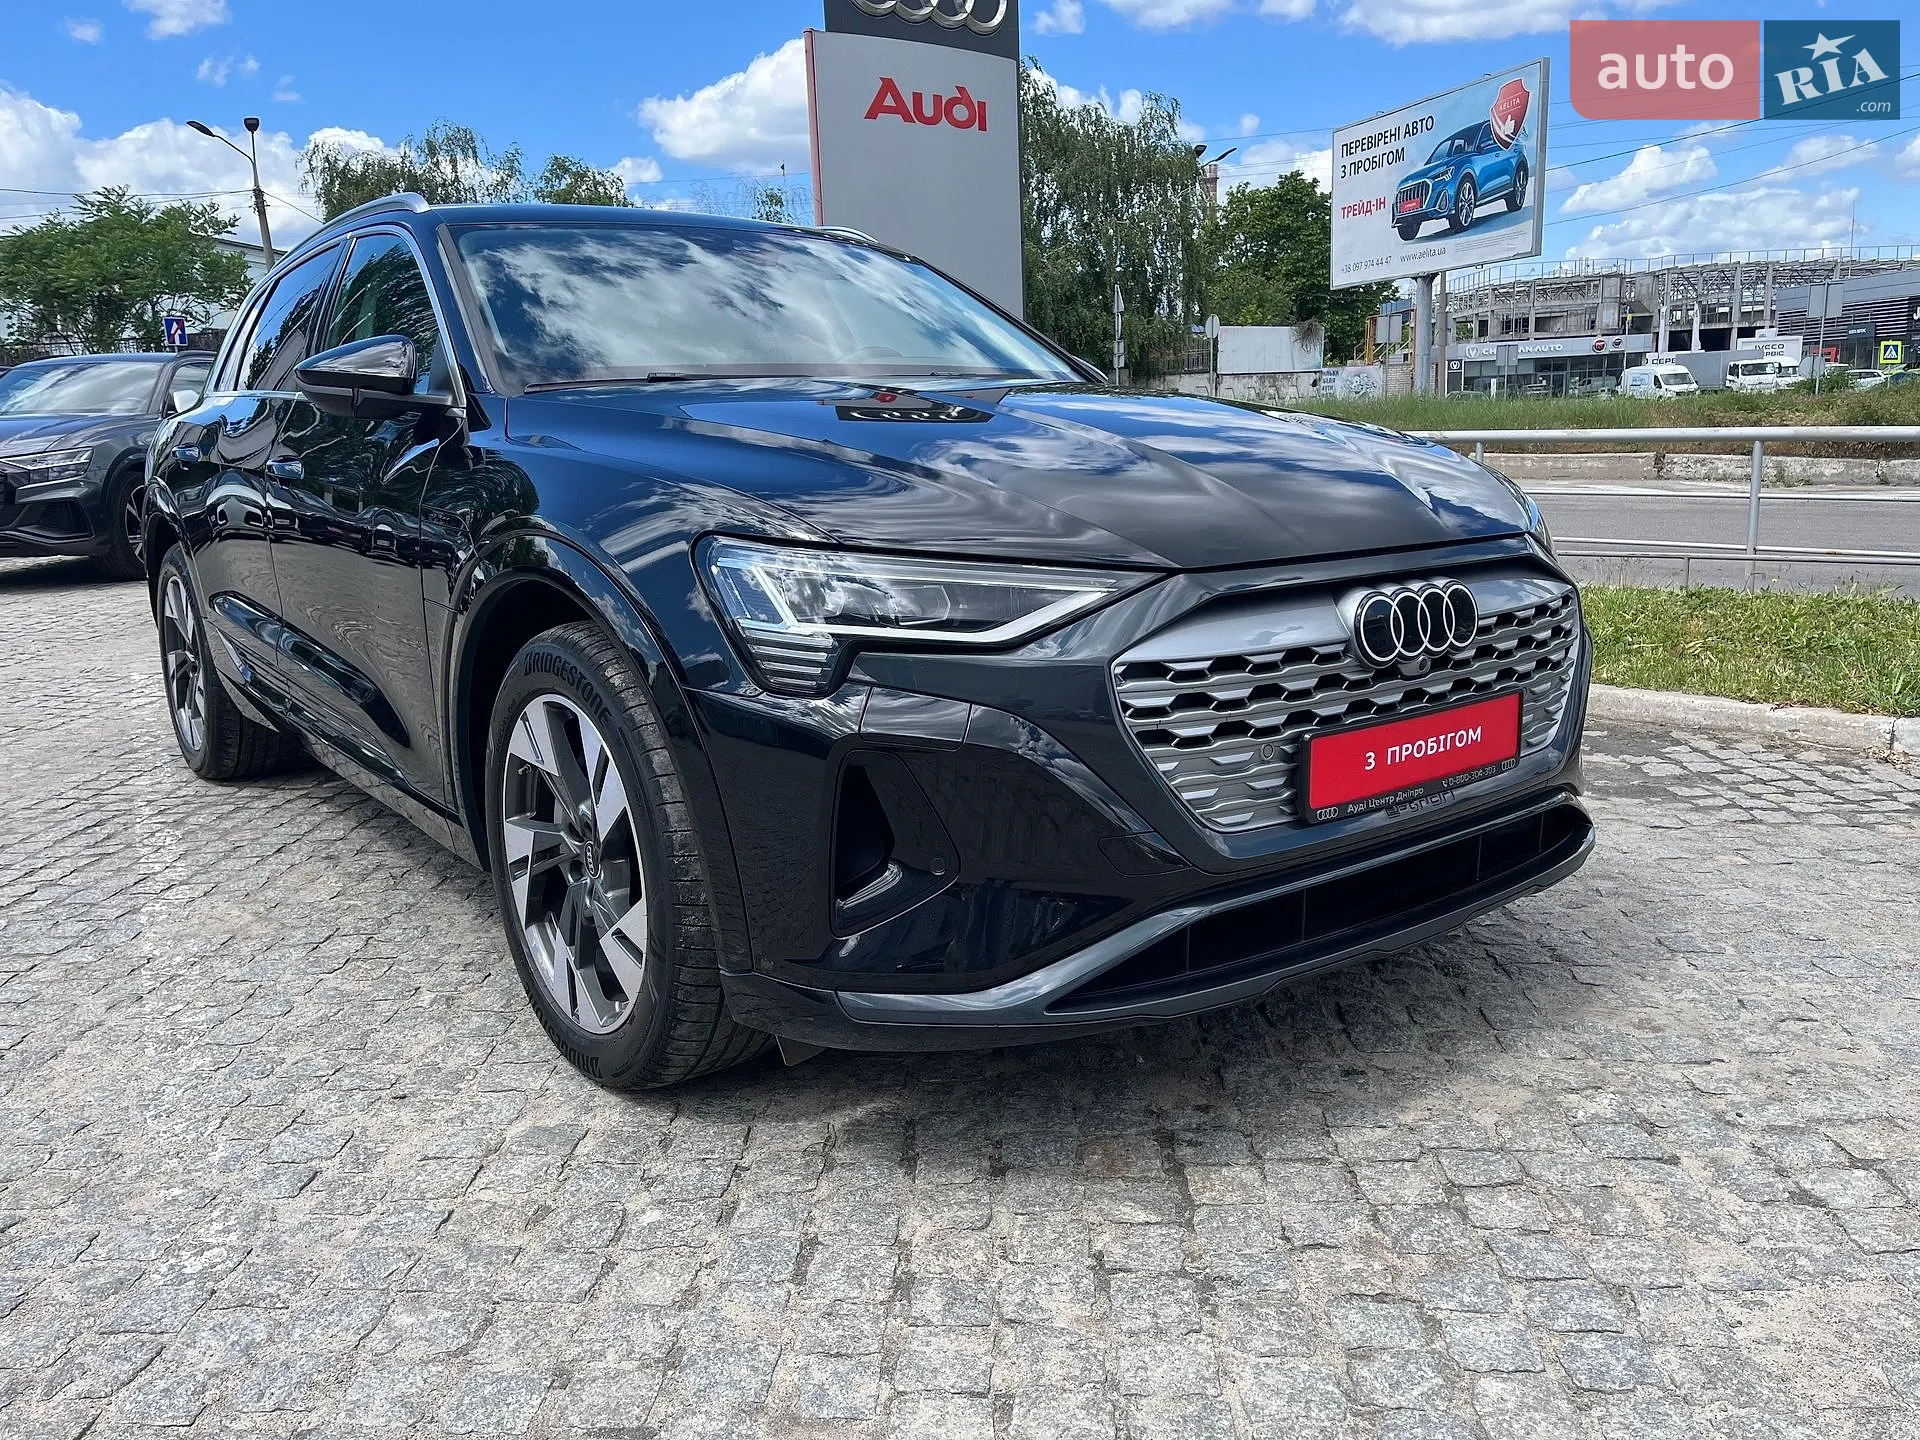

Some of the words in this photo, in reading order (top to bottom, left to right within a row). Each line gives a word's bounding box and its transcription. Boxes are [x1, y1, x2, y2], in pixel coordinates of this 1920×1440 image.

[864, 77, 987, 132] Audi
[1341, 126, 1400, 158] ПЕРЕВІРЕНІ
[1404, 115, 1434, 139] АВТО
[1349, 147, 1405, 177] ПРОБІГОМ
[1341, 196, 1386, 219] ТРЕЙД-ІН
[1400, 247, 1446, 262] www.aelita.ua
[1535, 344, 1563, 352] AUTO
[524, 651, 612, 726] BRIDGESTONE
[1364, 751, 1376, 770] З
[1386, 725, 1482, 766] ПРОБІГОМ
[1448, 766, 1496, 786] 0-800-304-303
[1347, 800, 1367, 814] Ауді
[1368, 795, 1395, 809] Центр
[1396, 787, 1424, 802] Дніпро
